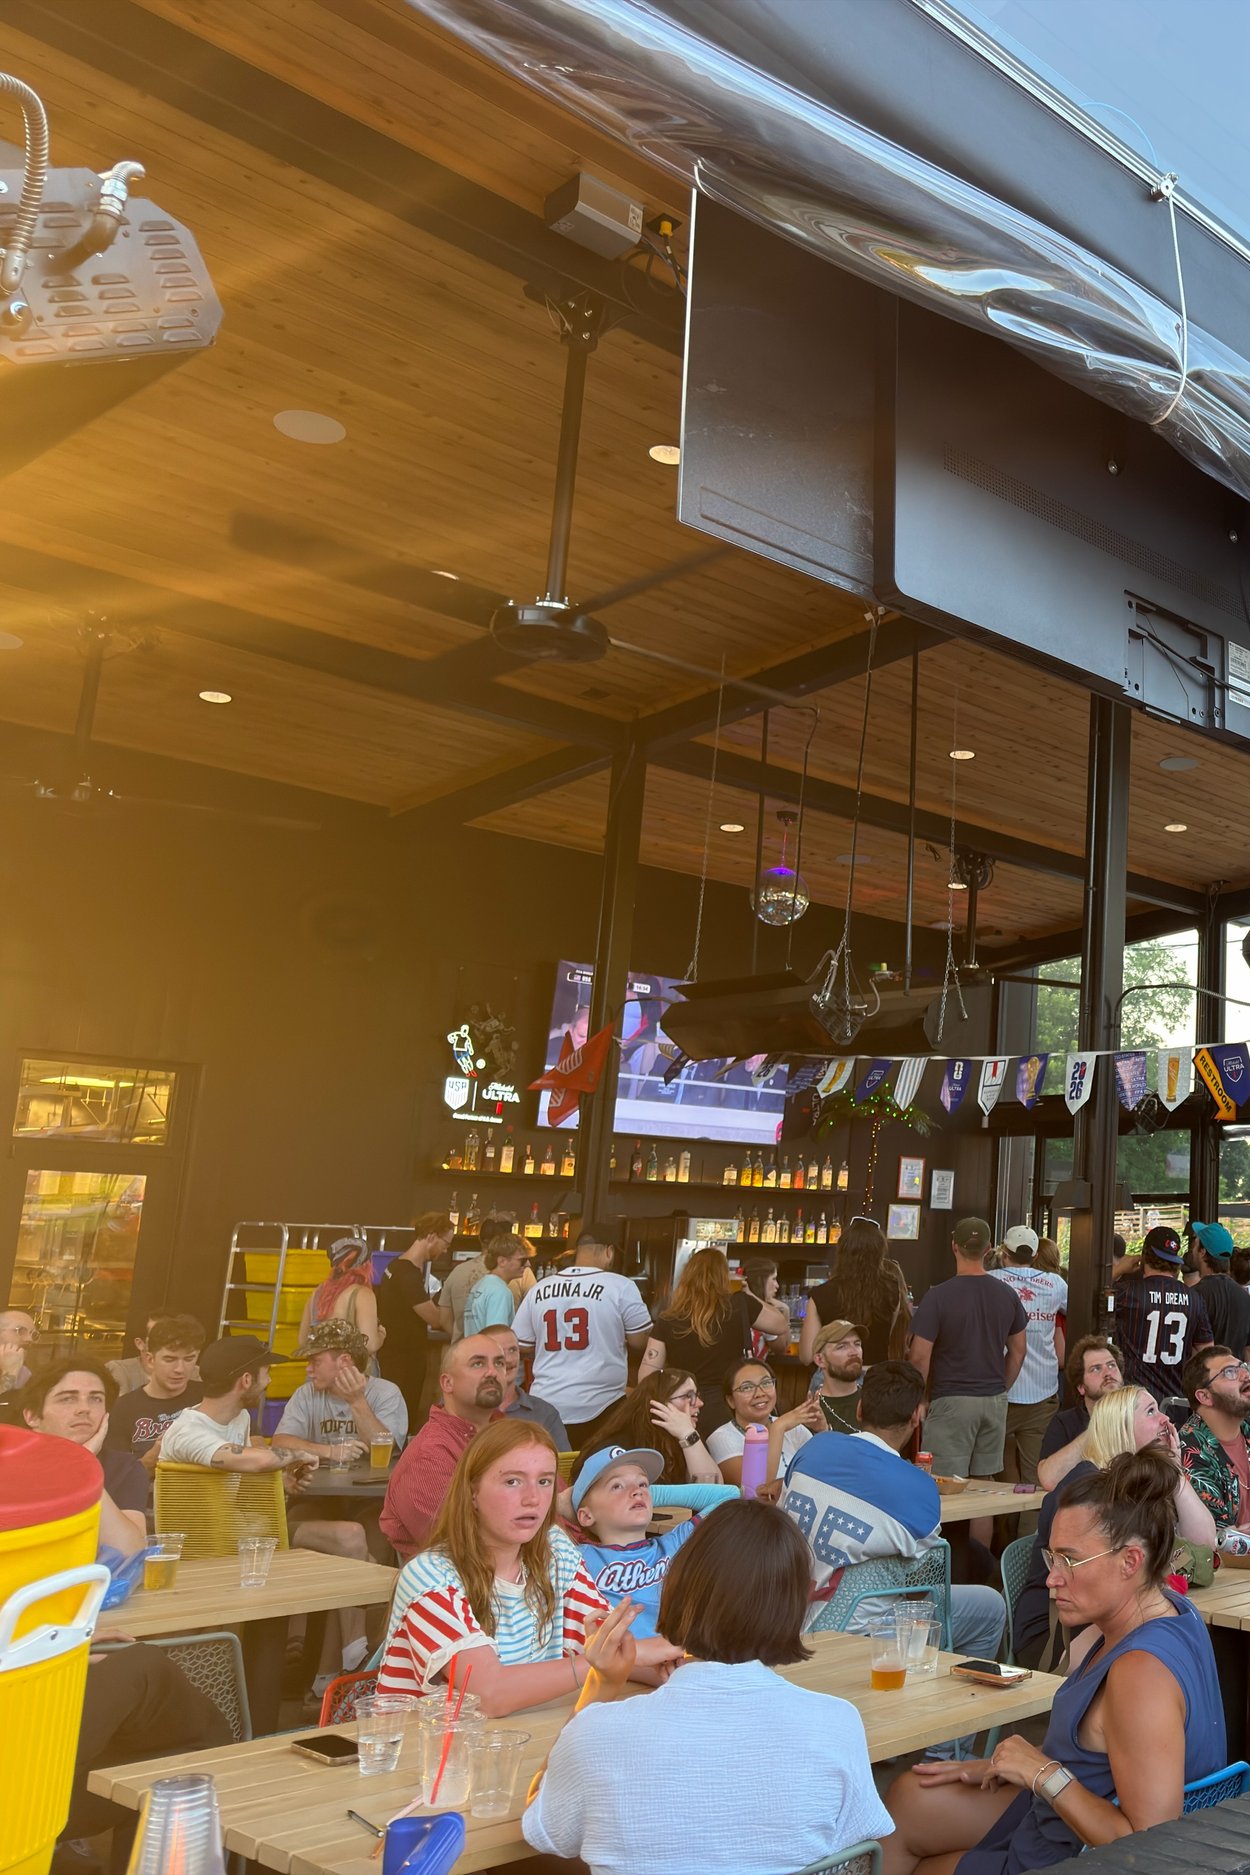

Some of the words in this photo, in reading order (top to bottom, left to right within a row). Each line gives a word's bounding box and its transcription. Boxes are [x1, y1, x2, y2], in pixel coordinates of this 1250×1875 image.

[1223, 1063, 1245, 1073] ULTRA
[448, 1080, 468, 1092] USA
[1068, 1080, 1084, 1101] 26
[1199, 1055, 1232, 1113] RESTROOM
[482, 1088, 521, 1104] ULTRA
[535, 1279, 581, 1304] ACUÑA
[583, 1283, 605, 1302] JR.
[1149, 1291, 1162, 1304] TIM
[1165, 1292, 1189, 1306] DREAM
[1026, 1308, 1057, 1321] eiser
[543, 1307, 590, 1352] 13
[1142, 1310, 1188, 1365] 13
[132, 1417, 174, 1443] Bra
